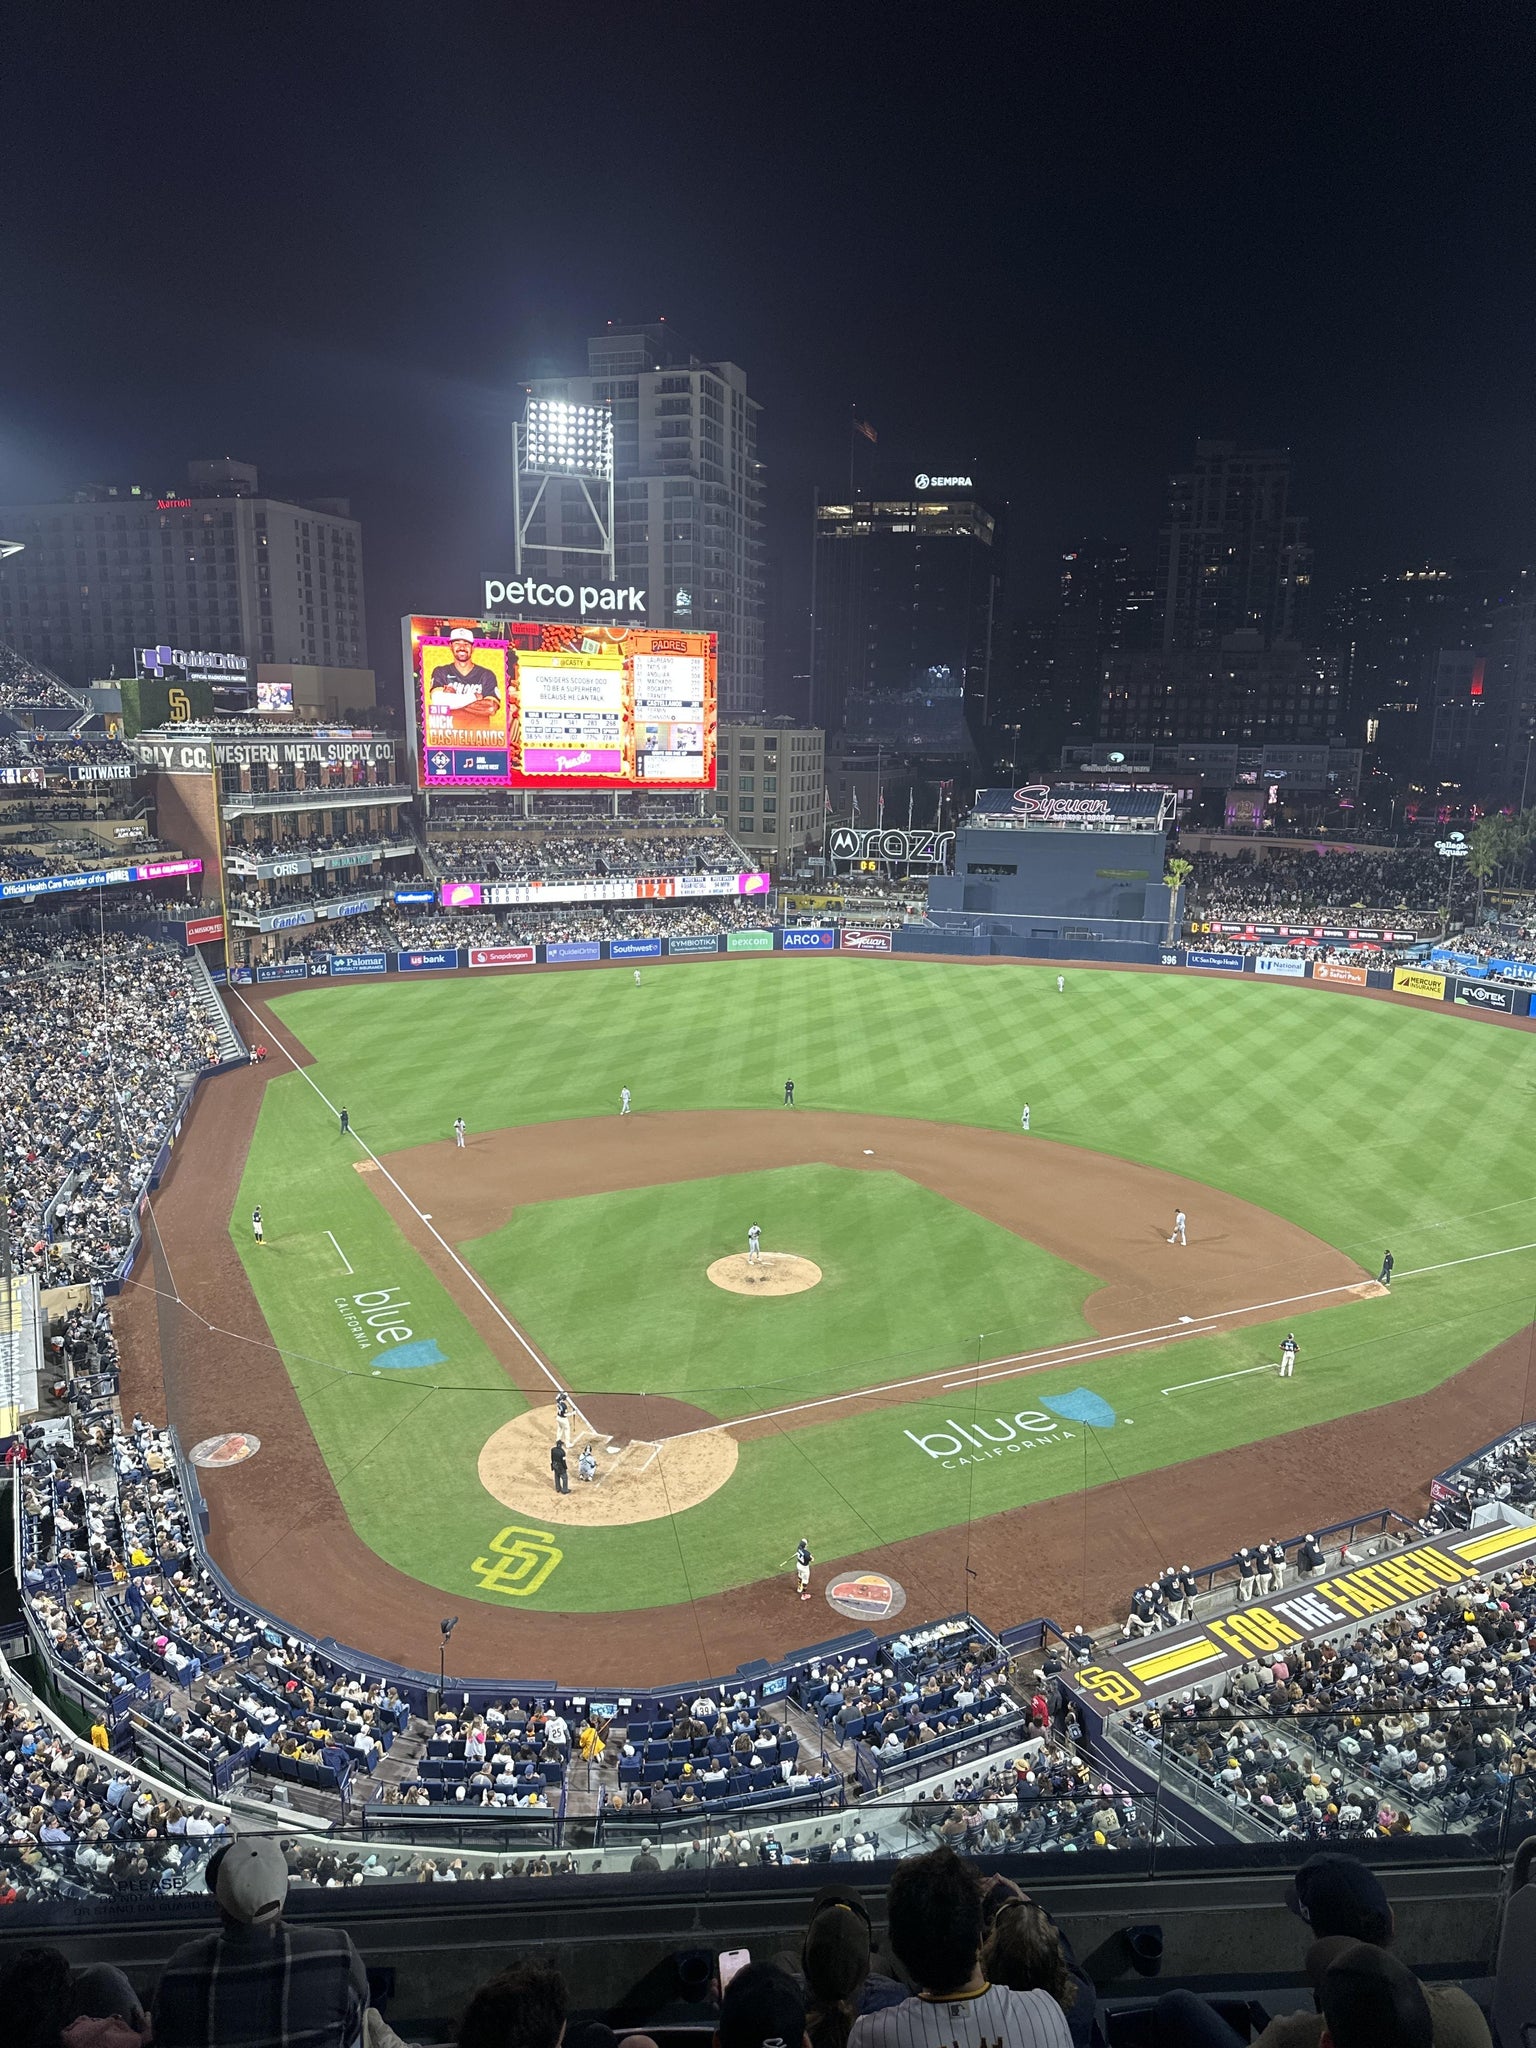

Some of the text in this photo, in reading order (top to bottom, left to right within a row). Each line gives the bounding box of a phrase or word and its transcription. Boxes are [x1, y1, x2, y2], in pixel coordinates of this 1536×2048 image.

[930, 477, 972, 487] SEMPRA
[156, 499, 192, 510] Marriott
[485, 577, 646, 615] petco park
[652, 640, 687, 653] PADRES
[173, 649, 248, 670] QuidelOrtho
[429, 715, 454, 729] NICK
[429, 729, 505, 746] CASTELLANOS
[214, 743, 394, 764] WESTERN METAL SUPPLY CO.
[78, 765, 131, 780] CUTWATER
[1011, 784, 1112, 821] Sycuan
[273, 862, 299, 877] ORIS
[3, 885, 26, 896] Official
[26, 881, 48, 893] Health
[48, 879, 62, 890] Care
[63, 877, 88, 888] Provider
[88, 875, 95, 885] of
[95, 874, 106, 884] the
[194, 925, 214, 935] MISSION
[670, 938, 717, 948] CYMBIOTIKA
[785, 934, 820, 945] ARCO
[844, 931, 887, 948] Sycuan
[613, 944, 653, 954] Southwest
[346, 957, 383, 966] Palomar
[489, 951, 529, 961] Snapdragon
[1161, 955, 1177, 965] 396
[1221, 958, 1239, 966] Health
[310, 964, 328, 976] 342
[1273, 961, 1302, 970] National
[1330, 971, 1362, 982] Safari Park
[1410, 976, 1442, 988] MERCURY
[1410, 983, 1441, 993] INSURANCE
[1462, 987, 1506, 1003] EVOTEK
[353, 1286, 413, 1344] blue
[334, 1297, 372, 1350] CALIFORNIA
[903, 1410, 1058, 1459] blue
[941, 1430, 1077, 1470] CALIFORNIA
[470, 1525, 564, 1596] SD
[1206, 1545, 1480, 1660] FOR THE FAITHFUL
[1073, 1665, 1142, 1706] SD
[551, 1727, 562, 1738] 25
[1105, 1815, 1117, 1827] 23
[1125, 1811, 1137, 1822] 13
[769, 1850, 777, 1860] 3
[117, 1877, 184, 1892] PLEASE
